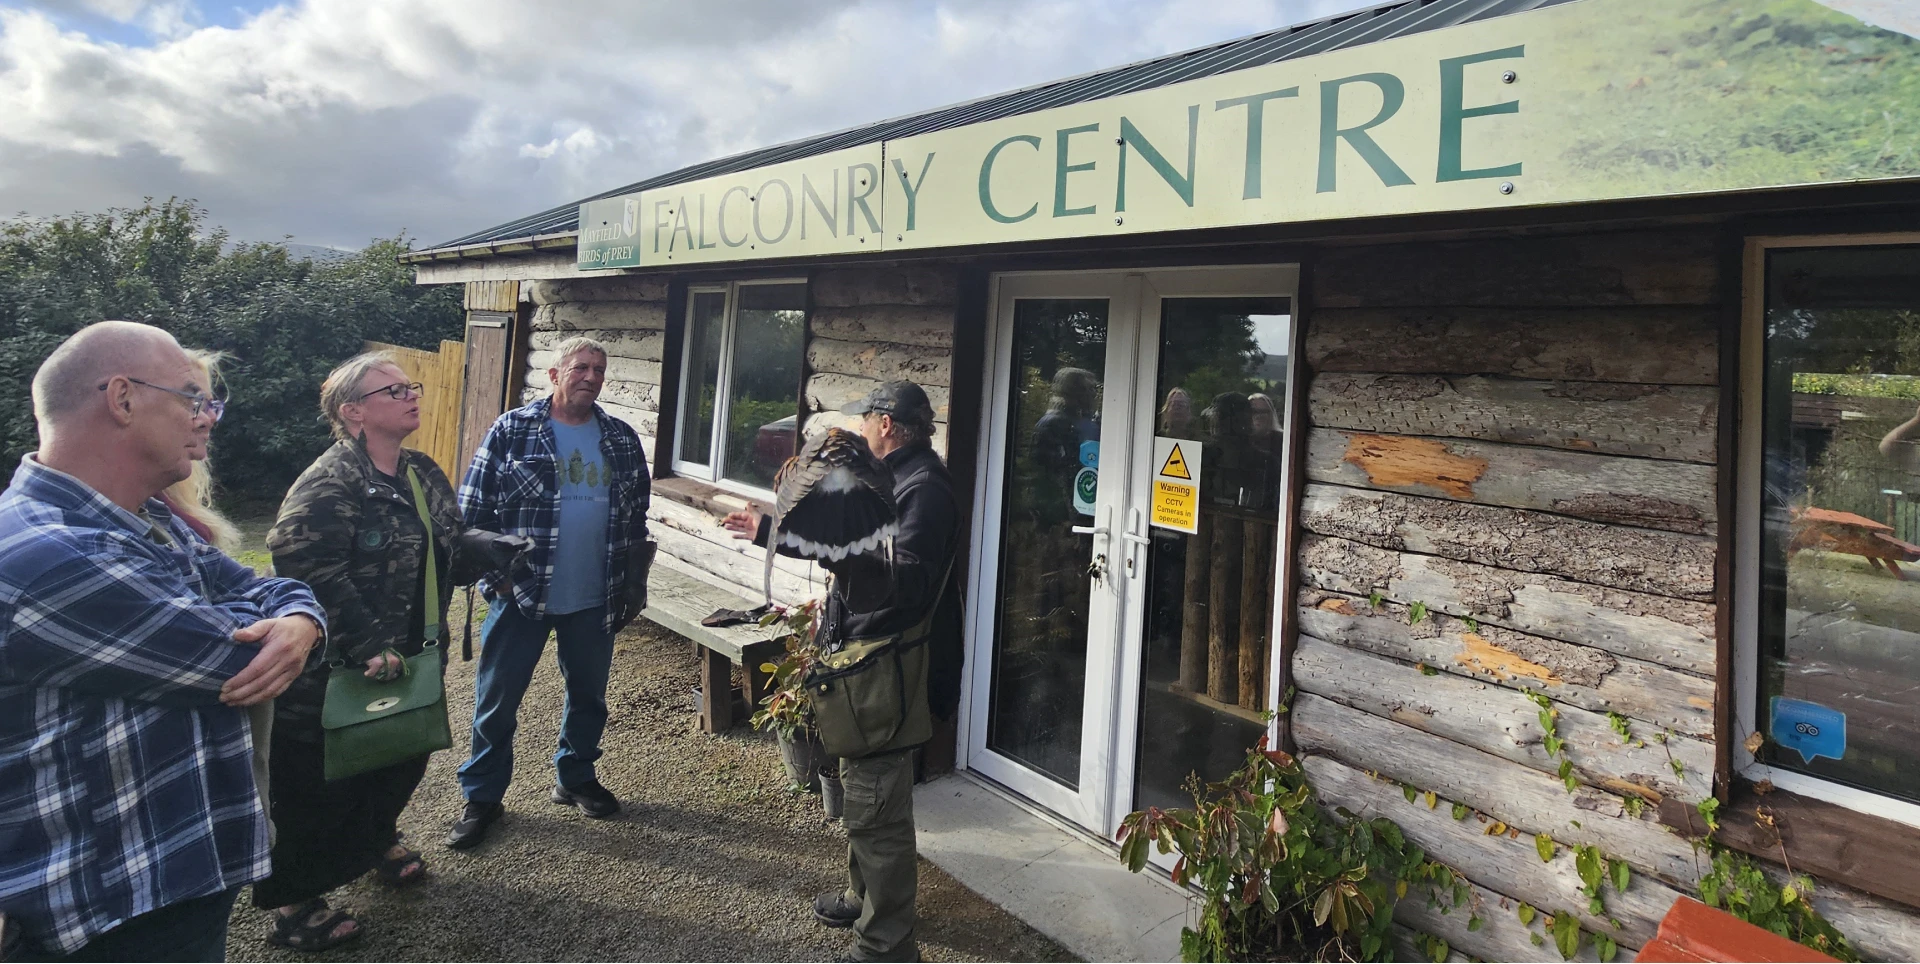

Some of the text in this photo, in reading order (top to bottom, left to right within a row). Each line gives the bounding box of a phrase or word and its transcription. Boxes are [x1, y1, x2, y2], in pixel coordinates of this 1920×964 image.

[653, 44, 1526, 254] FALCONRY CENTRE
[579, 223, 622, 243] MAYFIELD
[578, 246, 634, 266] BIRDS of PREY
[1160, 482, 1190, 497] Warning
[1165, 498, 1183, 506] CCTV
[1156, 504, 1192, 518] Cameras in
[1158, 515, 1188, 526] operation
